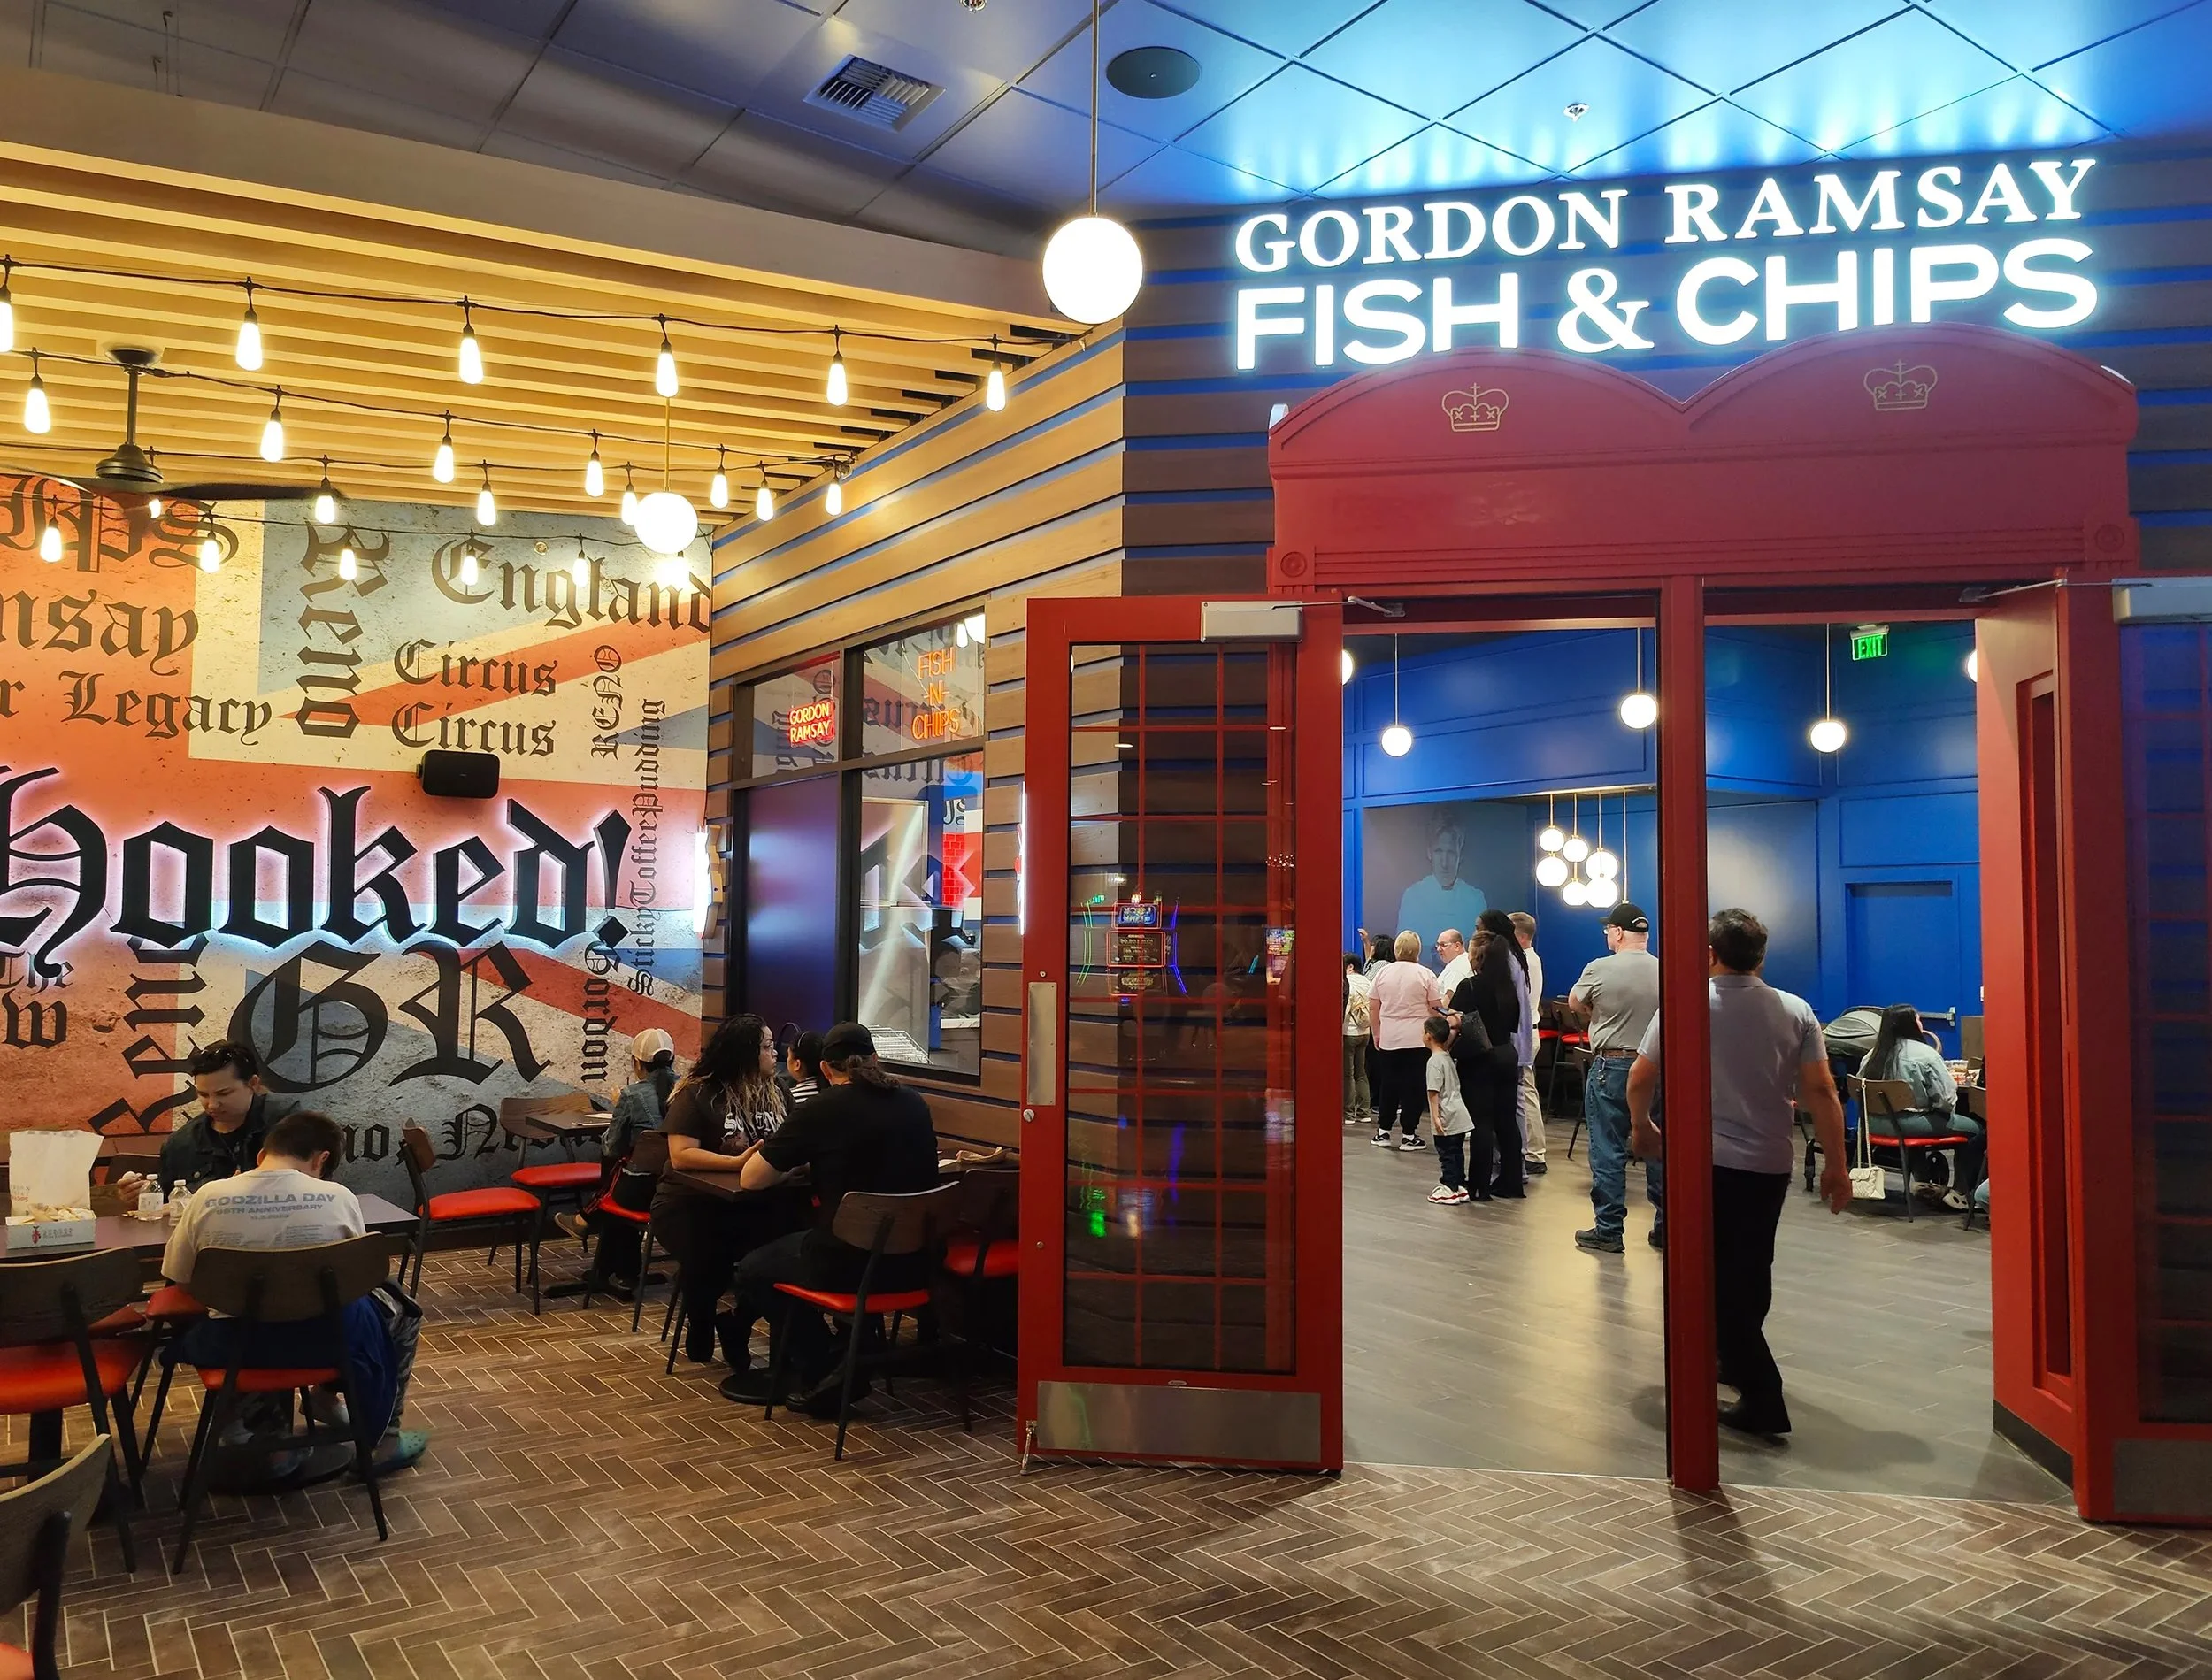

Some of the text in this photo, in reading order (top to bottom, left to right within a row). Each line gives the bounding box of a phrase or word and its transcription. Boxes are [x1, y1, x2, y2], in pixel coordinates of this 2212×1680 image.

[1234, 157, 2098, 273] GORDON RAMSAY
[1235, 236, 2099, 372] FISH & CHIPS
[432, 534, 710, 634] England
[294, 518, 390, 740] Reno
[1857, 634, 1884, 660] EXIT
[395, 638, 559, 697] Circus
[918, 647, 955, 680] FISH
[58, 670, 273, 747] Legacy
[391, 702, 557, 757] Circus
[590, 644, 623, 760] RENO
[789, 702, 831, 725] GORDON
[789, 719, 832, 743] RAMSAY
[911, 707, 961, 740] CHIPS
[0, 764, 633, 980] Hooked!
[227, 937, 551, 1094] GR
[580, 940, 619, 1084] Gordon
[204, 1193, 337, 1208] GODZILLA DAY
[247, 1203, 324, 1215] ANNIVERSARY
